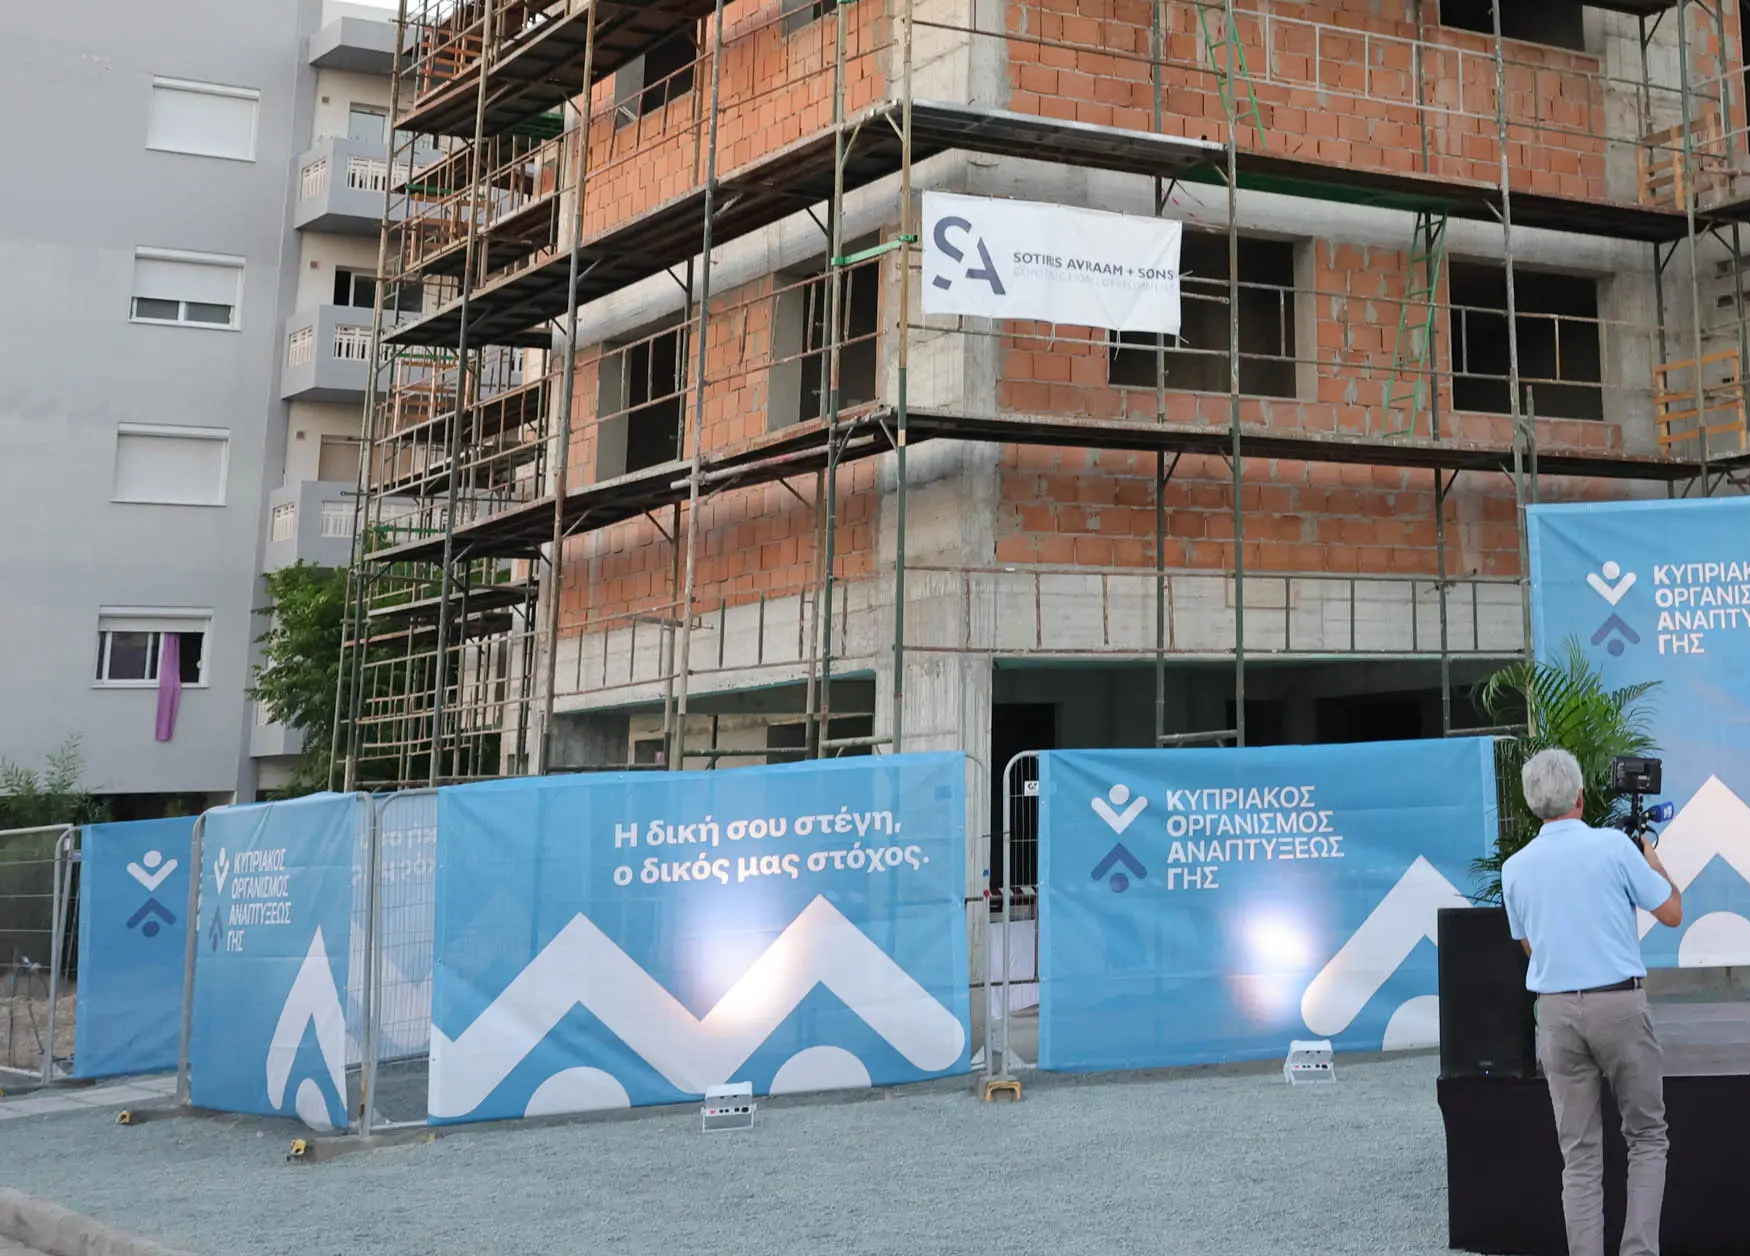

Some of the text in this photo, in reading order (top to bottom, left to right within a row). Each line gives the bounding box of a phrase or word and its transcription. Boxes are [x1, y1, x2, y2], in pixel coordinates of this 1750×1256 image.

[1013, 252, 1174, 280] SOTIRIS AVRAAM + SONS
[1658, 633, 1705, 655] ΓΗΣ
[1166, 785, 1315, 811] ΚΥΠΡΙΑΚΟΣ
[614, 806, 902, 848] Η δική σου στέγη,
[1166, 811, 1334, 837] ΟΡΓΑΝΙΣΜΟΣ
[234, 848, 287, 874] ΚΥΠΡΙΑΚΟΣ
[1167, 836, 1345, 864] ΑΝΑΠΤΥΞΕΩΣ
[613, 841, 930, 886] ο δικός μας στόχος.
[231, 874, 290, 900] ΟΡΓΑΝΙΣΜΟΣ
[1167, 866, 1219, 890] ΓΗΣ
[228, 902, 292, 927] ΑΝΑΠΤΥΞΕΩΣ
[226, 930, 245, 952] ΓΗΣ
